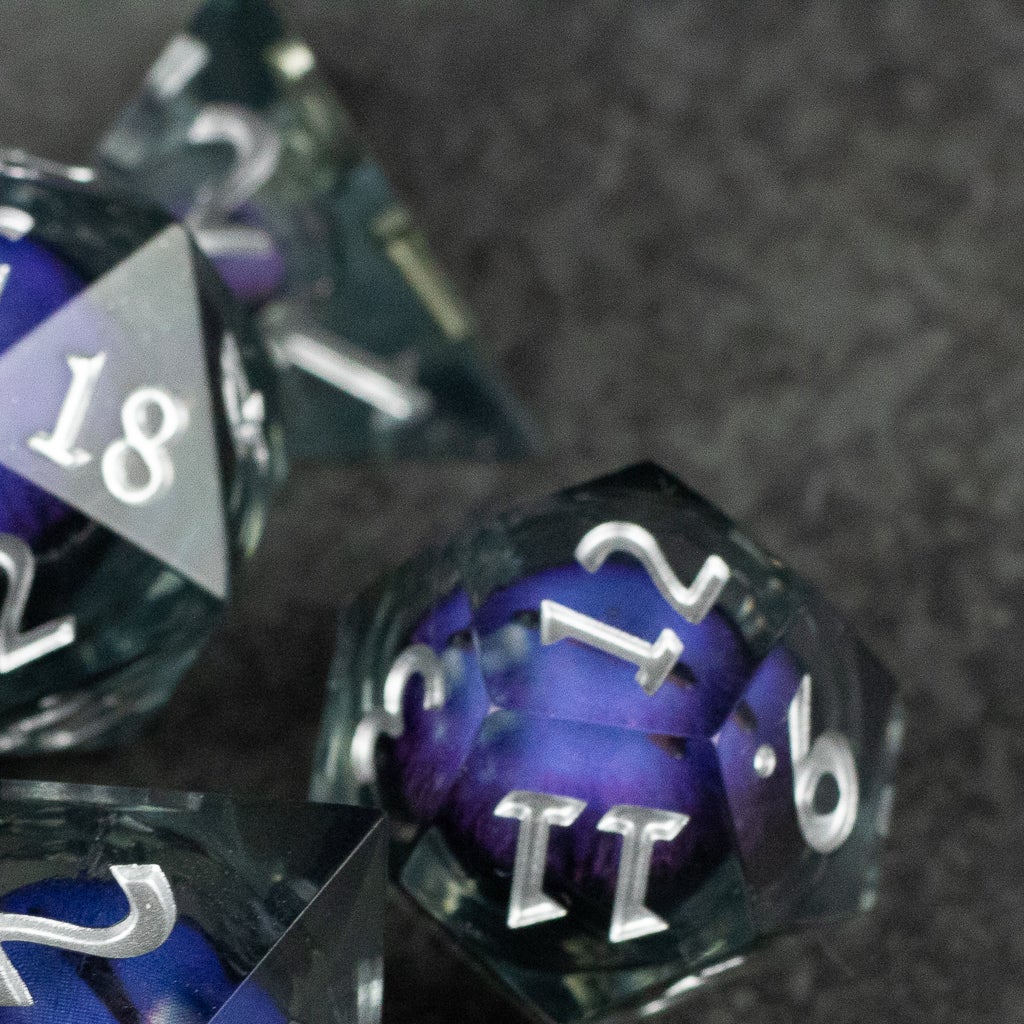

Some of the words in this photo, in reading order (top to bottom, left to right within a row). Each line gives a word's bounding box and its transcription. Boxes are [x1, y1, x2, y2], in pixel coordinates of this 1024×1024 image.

[28, 349, 190, 506] 18
[539, 521, 731, 697] 12
[493, 790, 690, 943] 11
